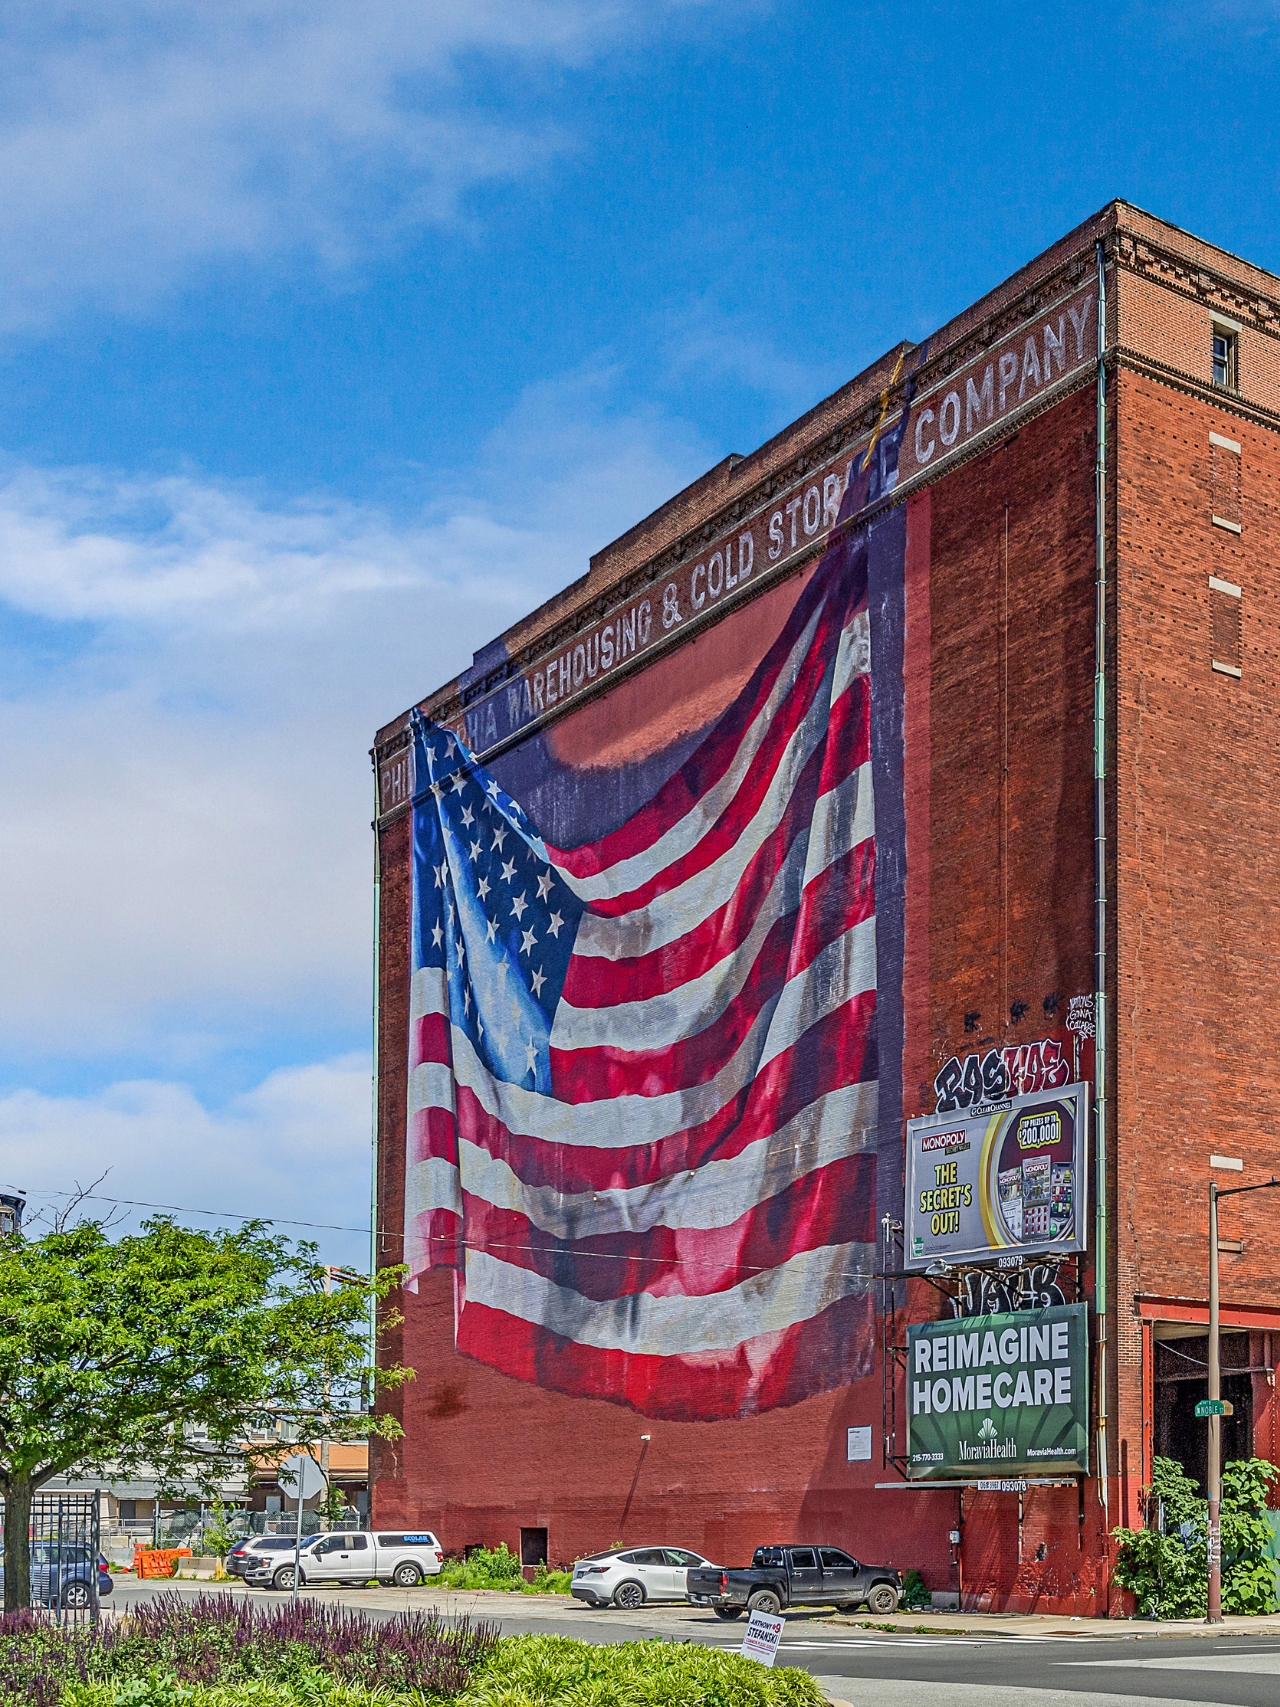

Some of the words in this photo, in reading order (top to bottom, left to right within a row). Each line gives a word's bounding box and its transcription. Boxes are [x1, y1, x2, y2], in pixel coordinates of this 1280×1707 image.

[507, 599, 653, 729] WAREHOUSING
[662, 582, 683, 629] &
[690, 530, 755, 611] COLD
[915, 294, 1093, 464] COMPANY
[922, 1130, 966, 1151] MONOPOLY
[934, 1162, 957, 1186] THE
[919, 1183, 972, 1213] SECRET'S
[931, 1211, 960, 1236] OUT!
[998, 1255, 1023, 1268] 093079
[914, 1321, 1069, 1374] REIMAGINE
[913, 1367, 1072, 1415] HOMECARE
[912, 1452, 944, 1462] 215-770-3333
[958, 1437, 1017, 1460] MoraviaHealth
[1026, 1447, 1077, 1457] MoraviaHealth.com
[1001, 1480, 1027, 1491] 093078
[750, 1619, 772, 1629] ANTHONY
[748, 1627, 777, 1644] STEFANSKI
